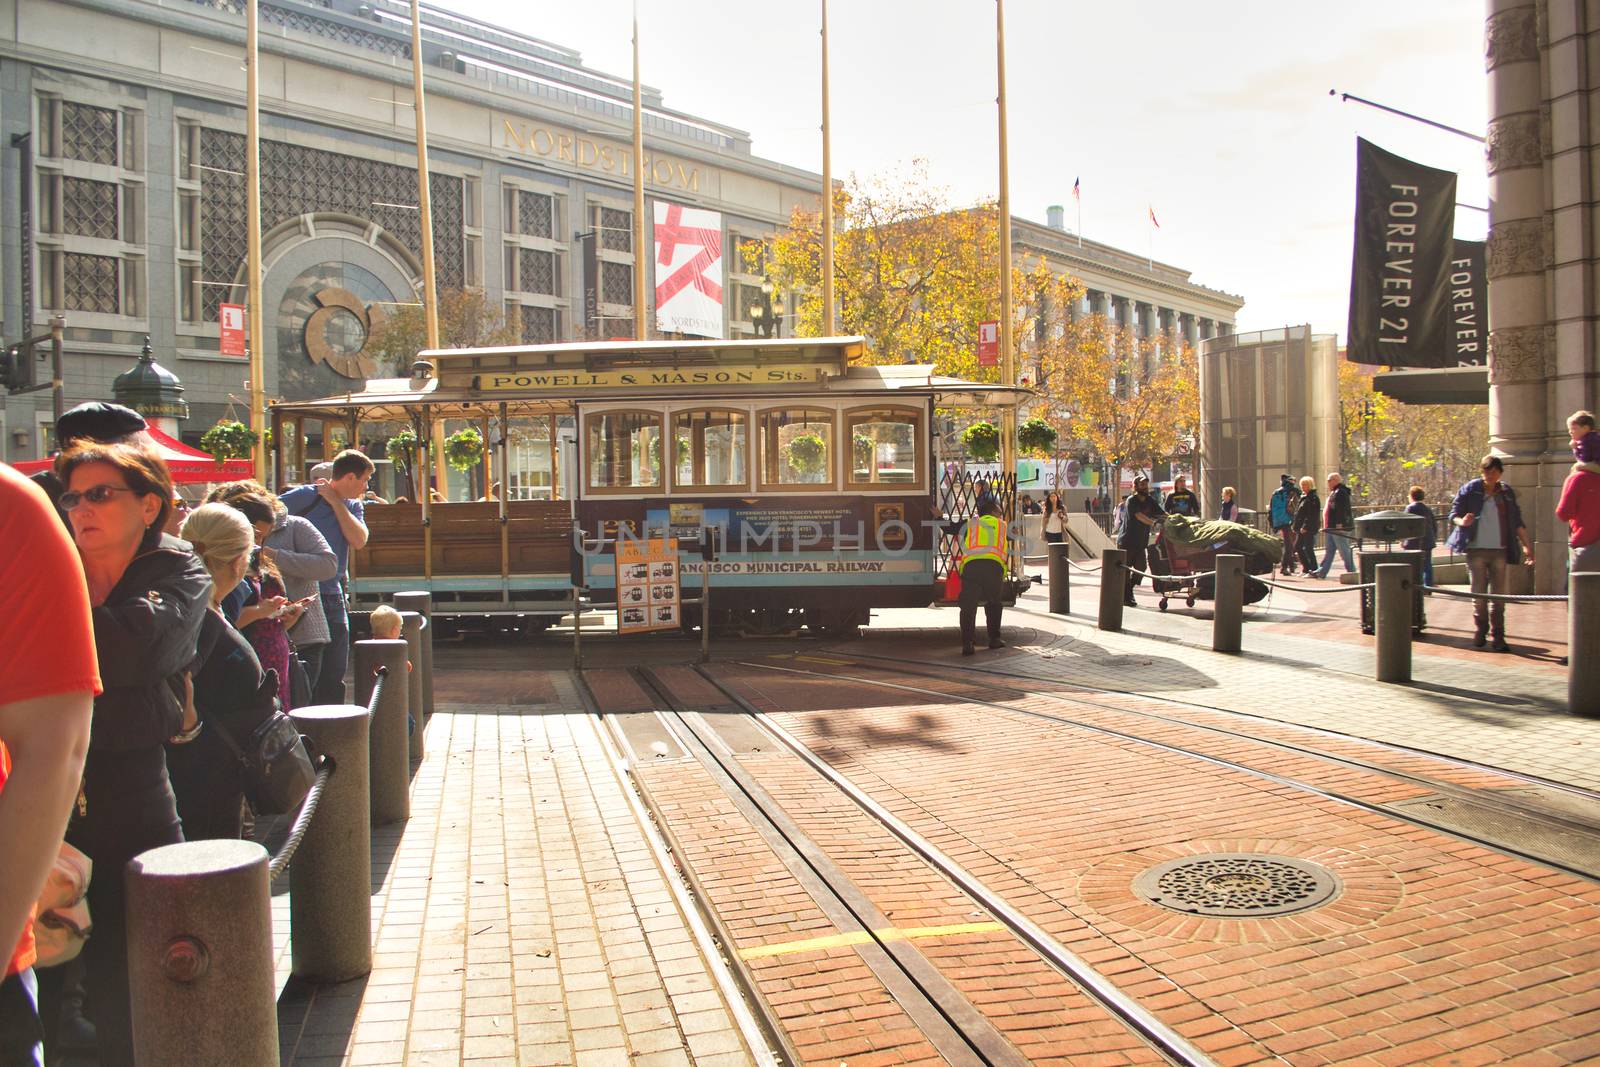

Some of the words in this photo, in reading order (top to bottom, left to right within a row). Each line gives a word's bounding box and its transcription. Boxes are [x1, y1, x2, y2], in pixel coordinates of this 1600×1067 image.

[504, 119, 699, 192] NORDSTROM
[1381, 184, 1418, 308] FOREVER
[1379, 317, 1408, 344] 21
[1451, 258, 1478, 354] FOREVER
[494, 375, 608, 388] POWELL
[620, 375, 638, 385] &
[651, 371, 754, 384] MASON
[767, 370, 808, 382] Sts.
[747, 562, 822, 573] MUNICIPAL
[827, 562, 884, 572] RAILWAY
